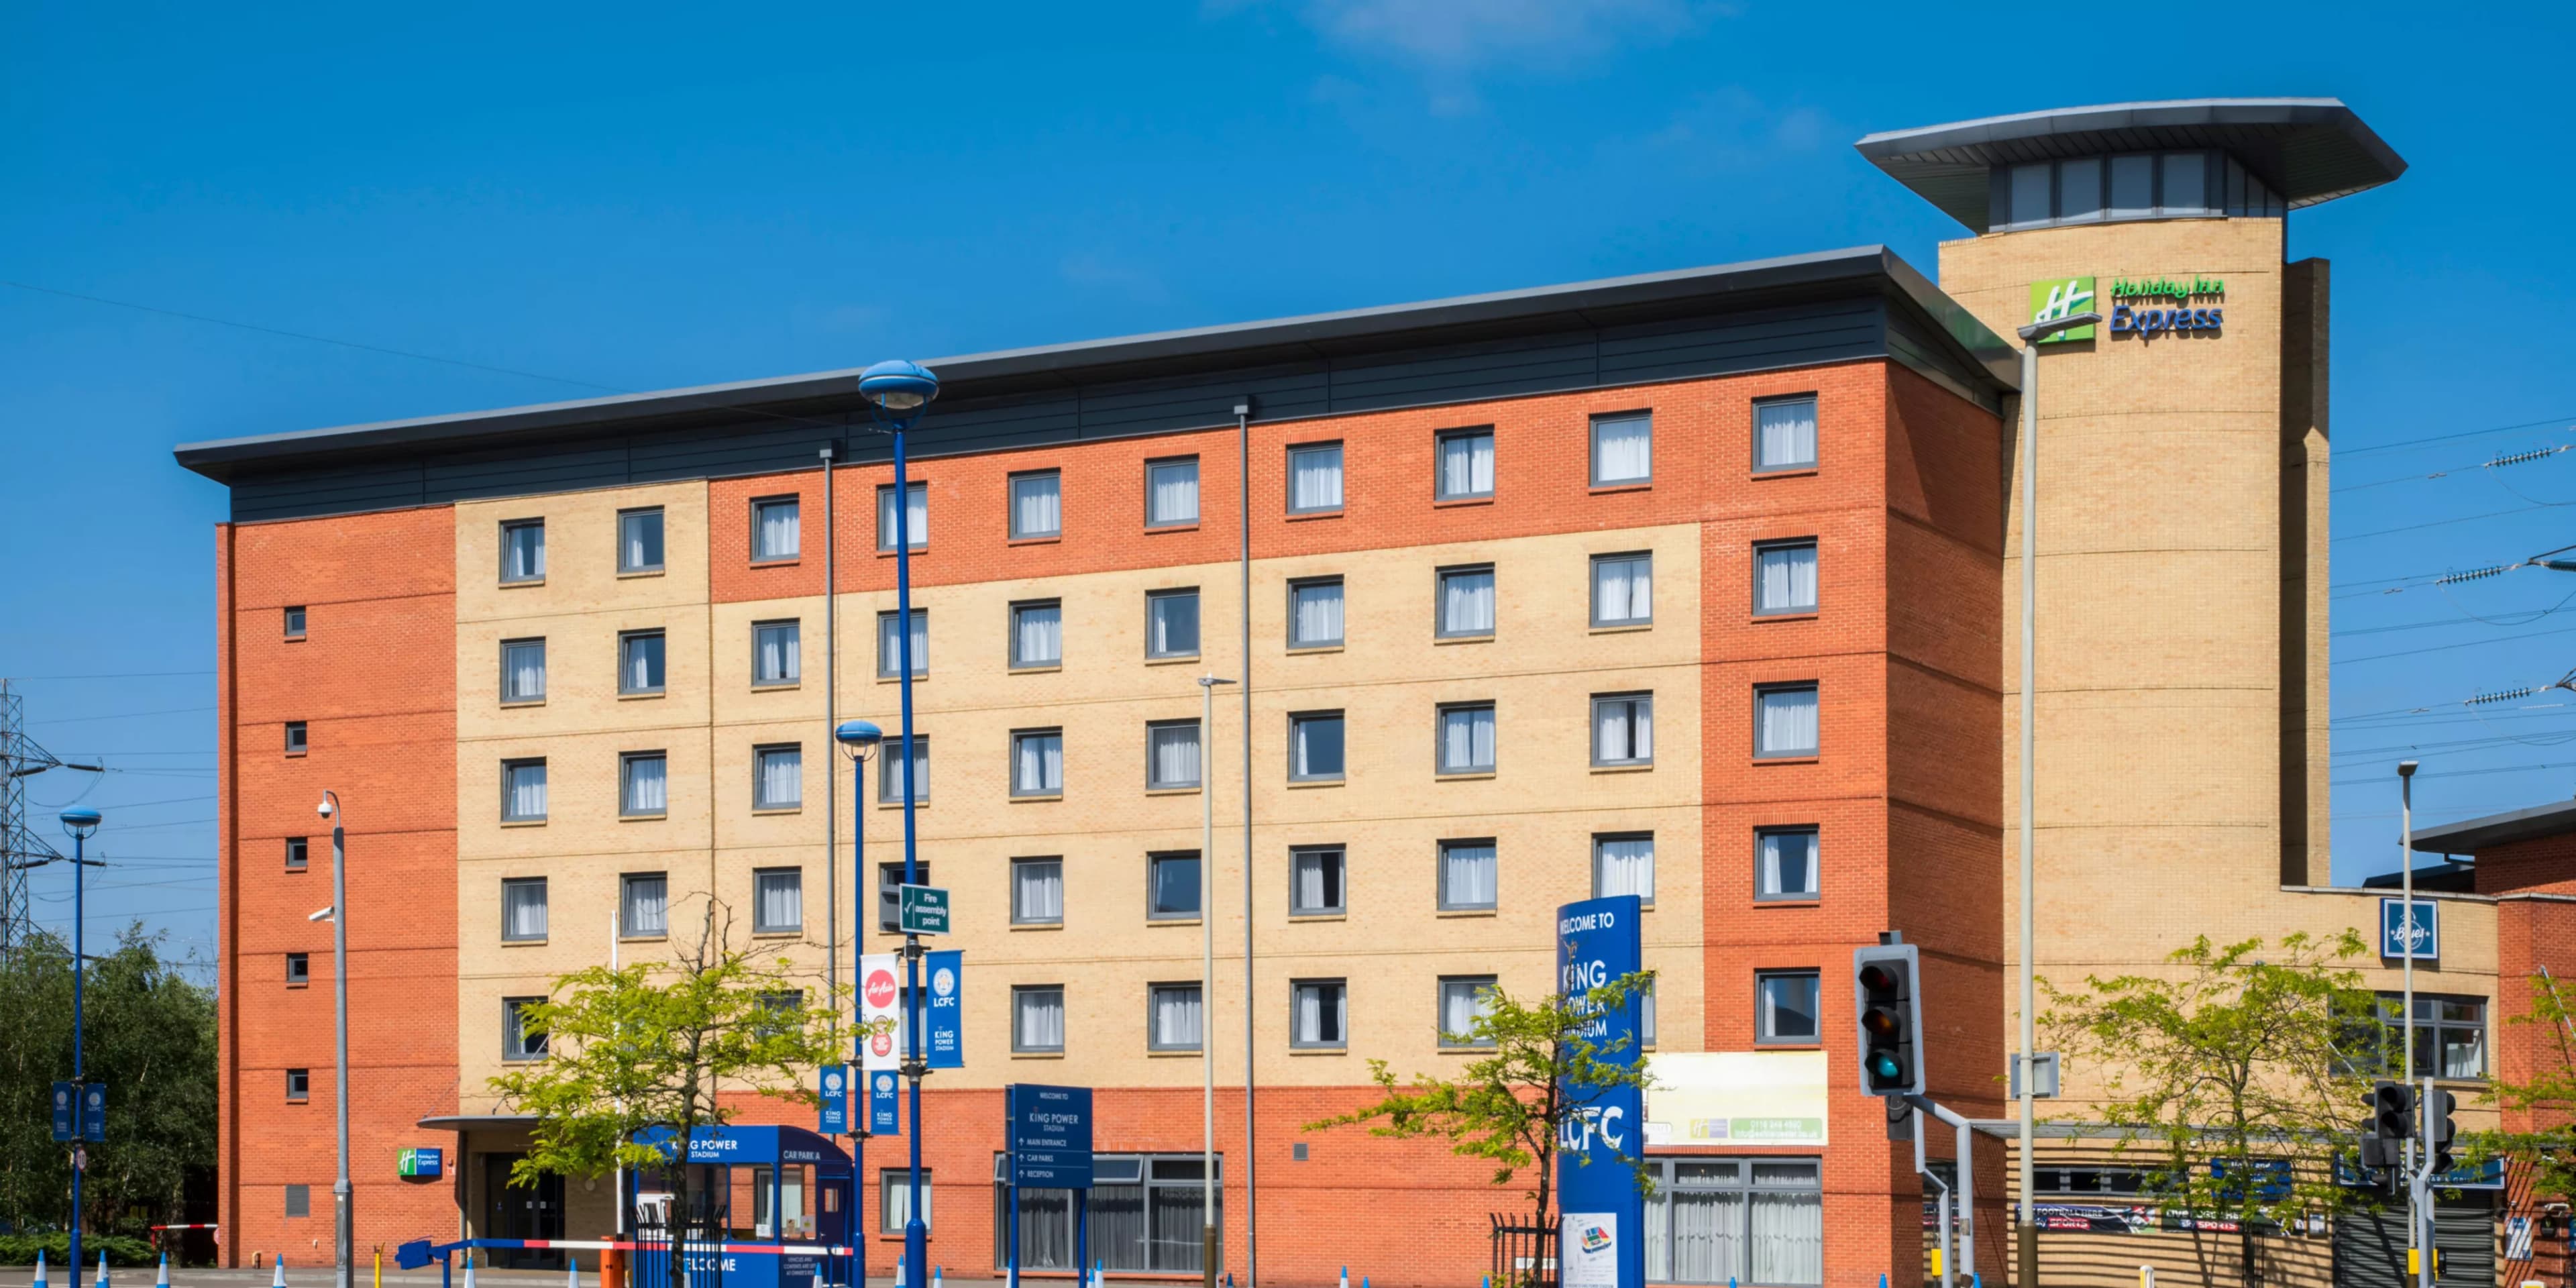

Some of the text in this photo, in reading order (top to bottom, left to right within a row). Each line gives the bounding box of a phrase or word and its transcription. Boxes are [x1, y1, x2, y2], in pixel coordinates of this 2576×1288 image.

[2111, 274, 2224, 299] Holiday Inn
[2109, 305, 2222, 337] Express
[924, 893, 937, 903] Fire
[915, 905, 947, 917] assembly
[922, 916, 940, 926] point
[1560, 912, 1614, 935] WELCOME TO
[934, 997, 955, 1007] LCFC
[1567, 995, 1605, 1015] OWER
[934, 1030, 954, 1038] KING
[1029, 1113, 1078, 1124] KING POWER
[1560, 1106, 1623, 1150] LCFC
[672, 1140, 737, 1150] KG POWER
[784, 1150, 820, 1160] CAR PARK A
[1026, 1170, 1054, 1178] RECEPTION
[2037, 1208, 2080, 1217] FOOTBALL
[2049, 1218, 2088, 1228] SPORTS
[683, 1258, 736, 1271] ELCOME
